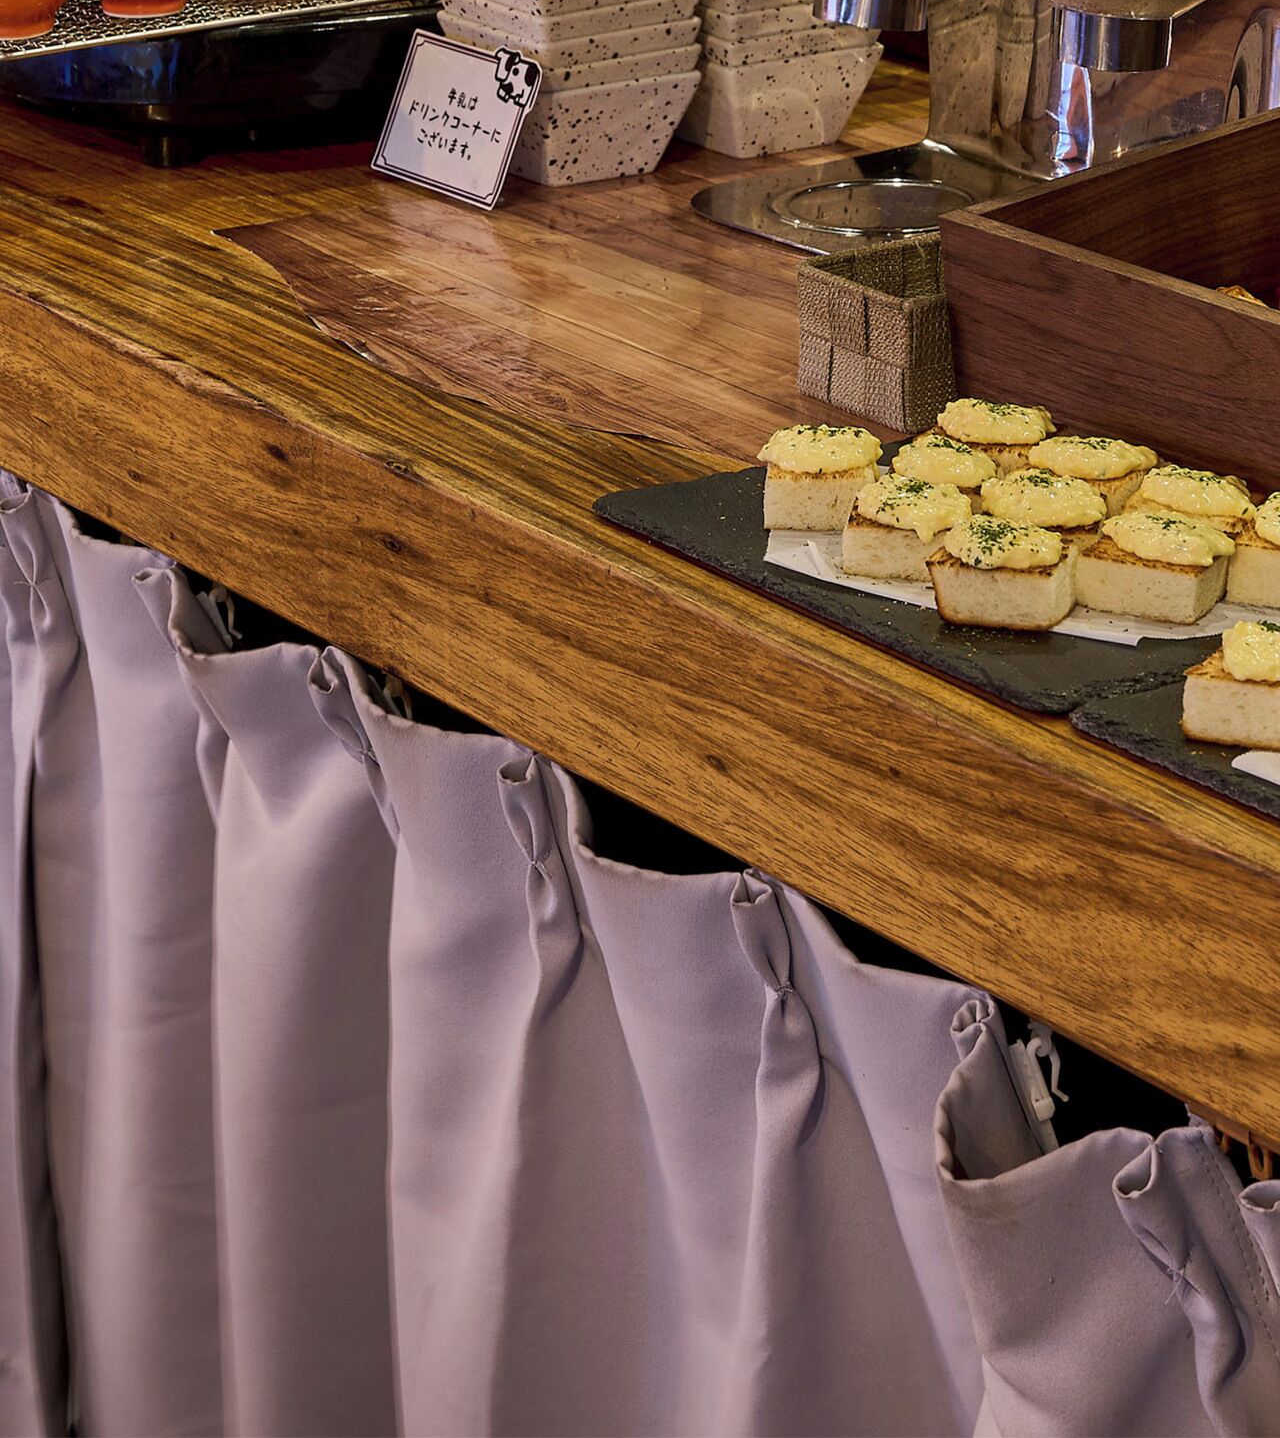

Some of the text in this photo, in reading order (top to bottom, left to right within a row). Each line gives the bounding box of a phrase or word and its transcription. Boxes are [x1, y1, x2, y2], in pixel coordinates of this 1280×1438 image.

[447, 87, 479, 111] 牛乳は
[407, 99, 502, 144] ドリンクコーナーに
[416, 128, 472, 161] ございます。
